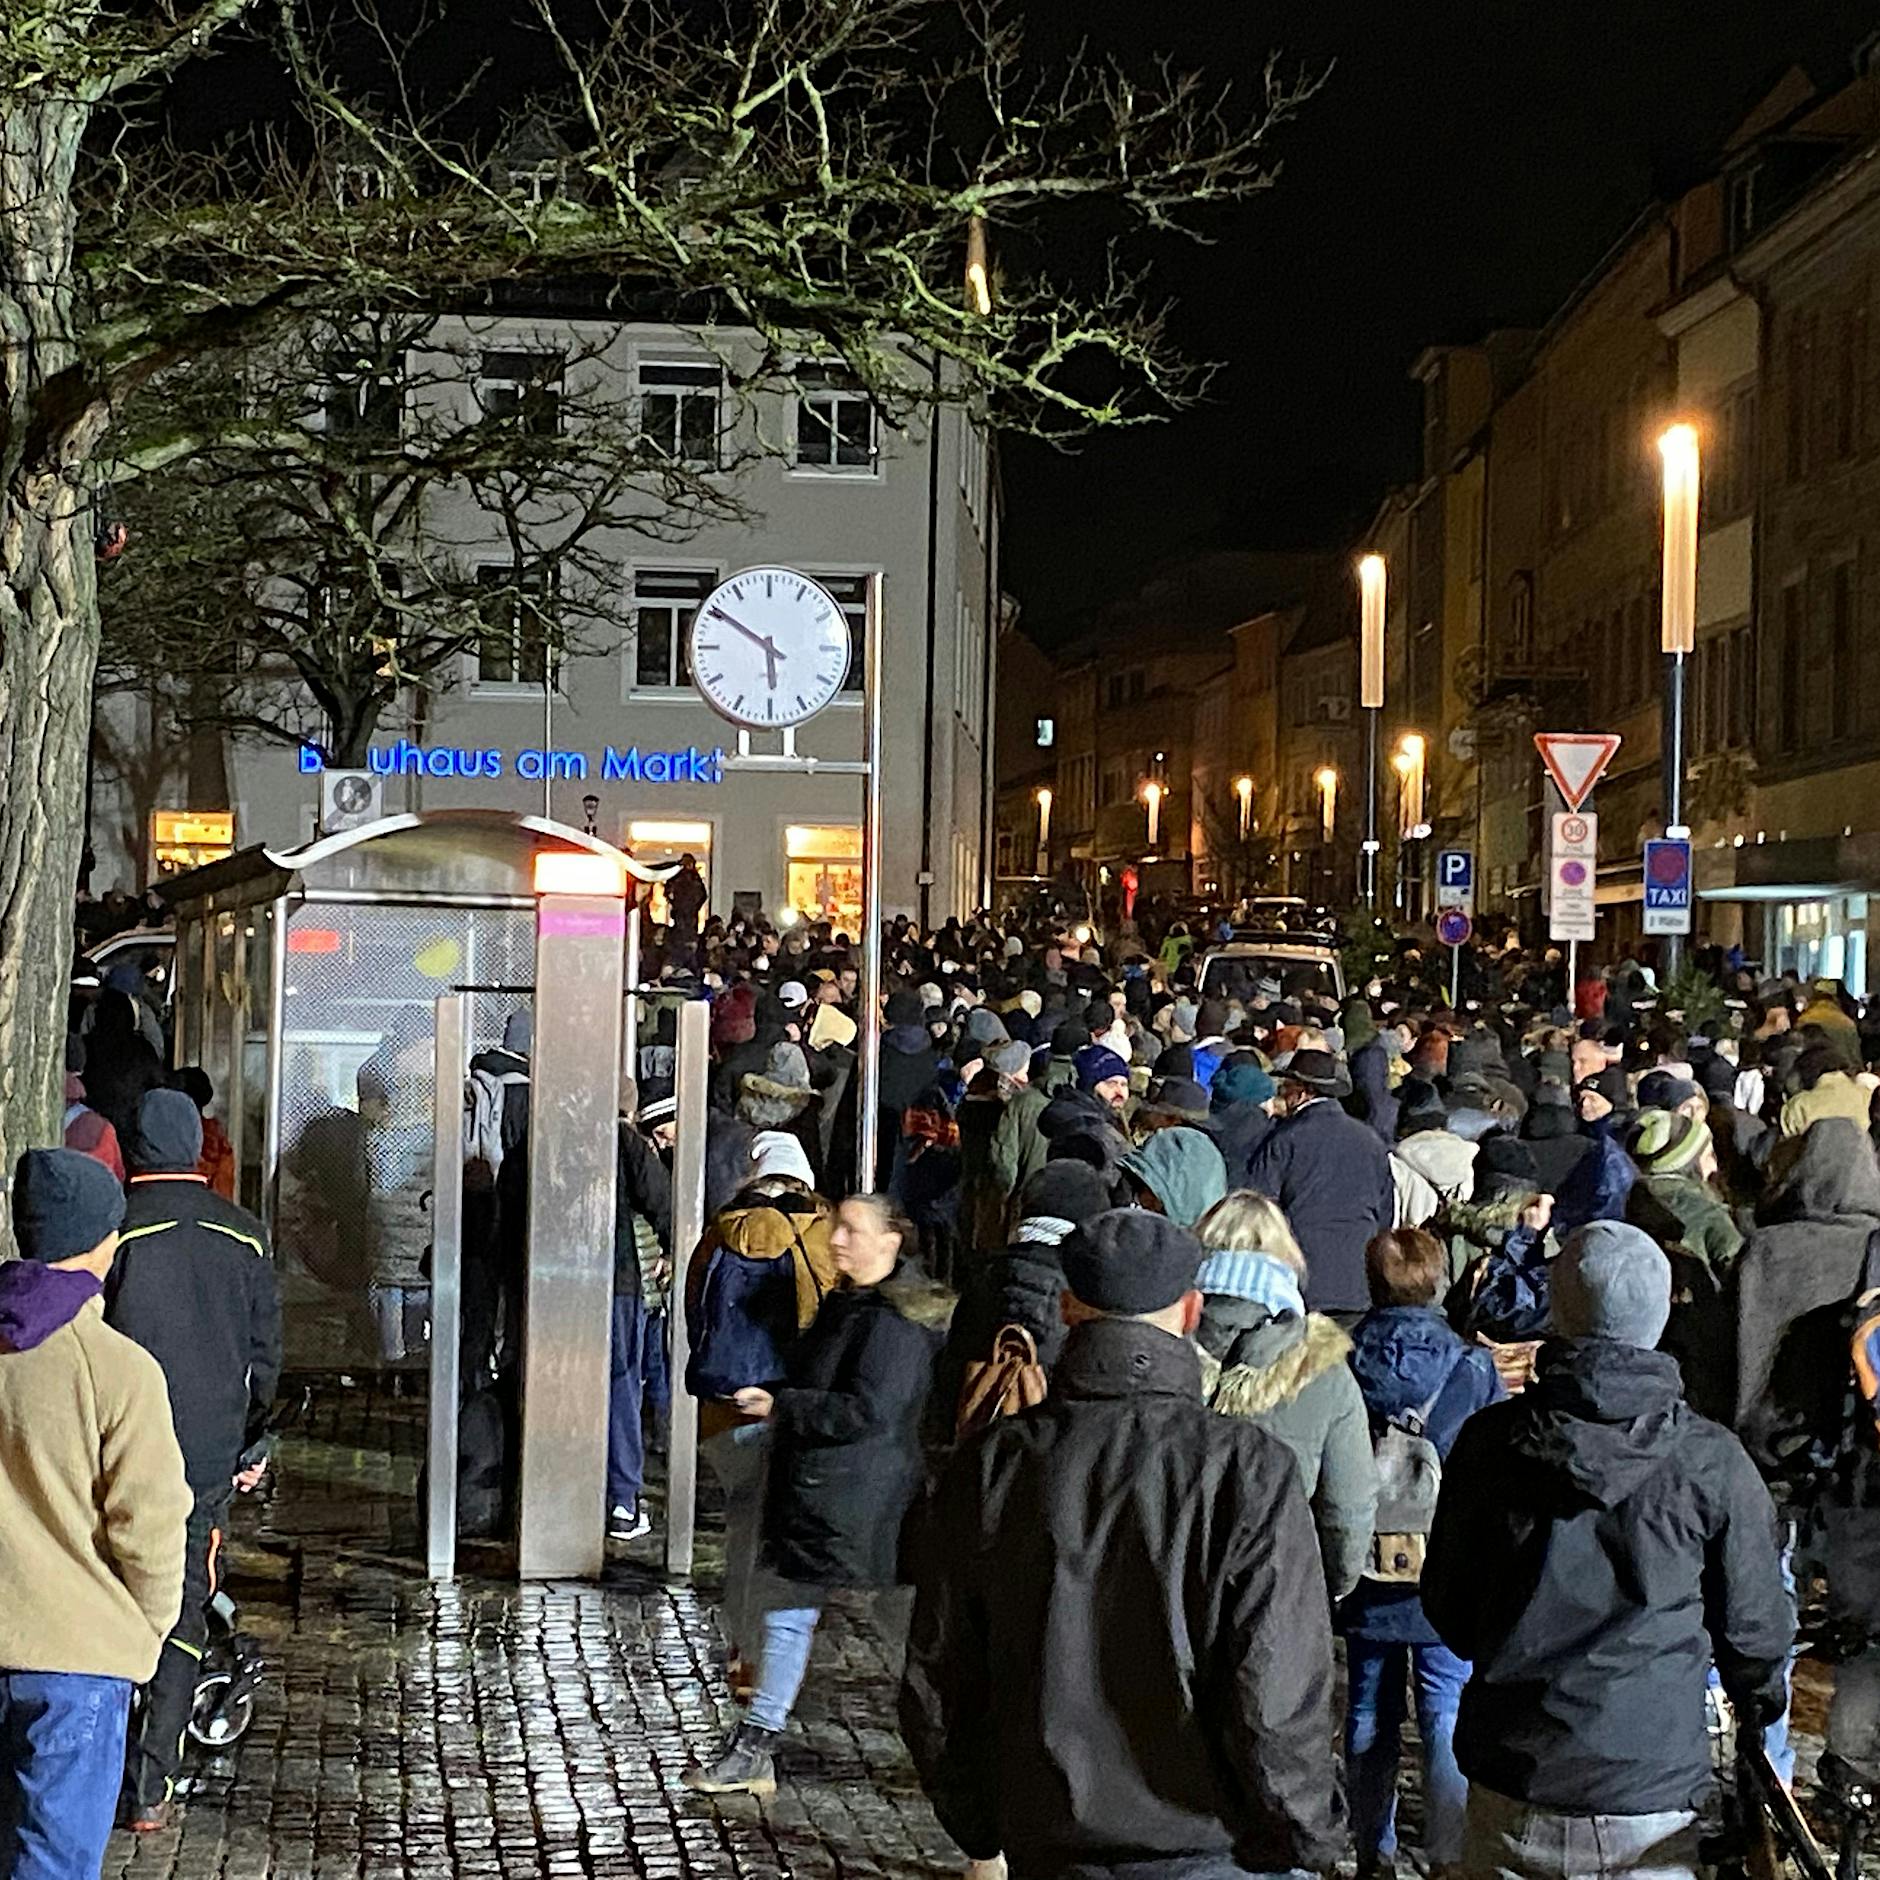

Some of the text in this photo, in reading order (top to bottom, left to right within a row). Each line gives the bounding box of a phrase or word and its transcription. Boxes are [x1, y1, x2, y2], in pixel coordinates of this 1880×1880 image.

[299, 738, 502, 779] Buhaus
[515, 748, 588, 780] am
[1446, 854, 1466, 883] P
[1649, 888, 1687, 905] TAXI
